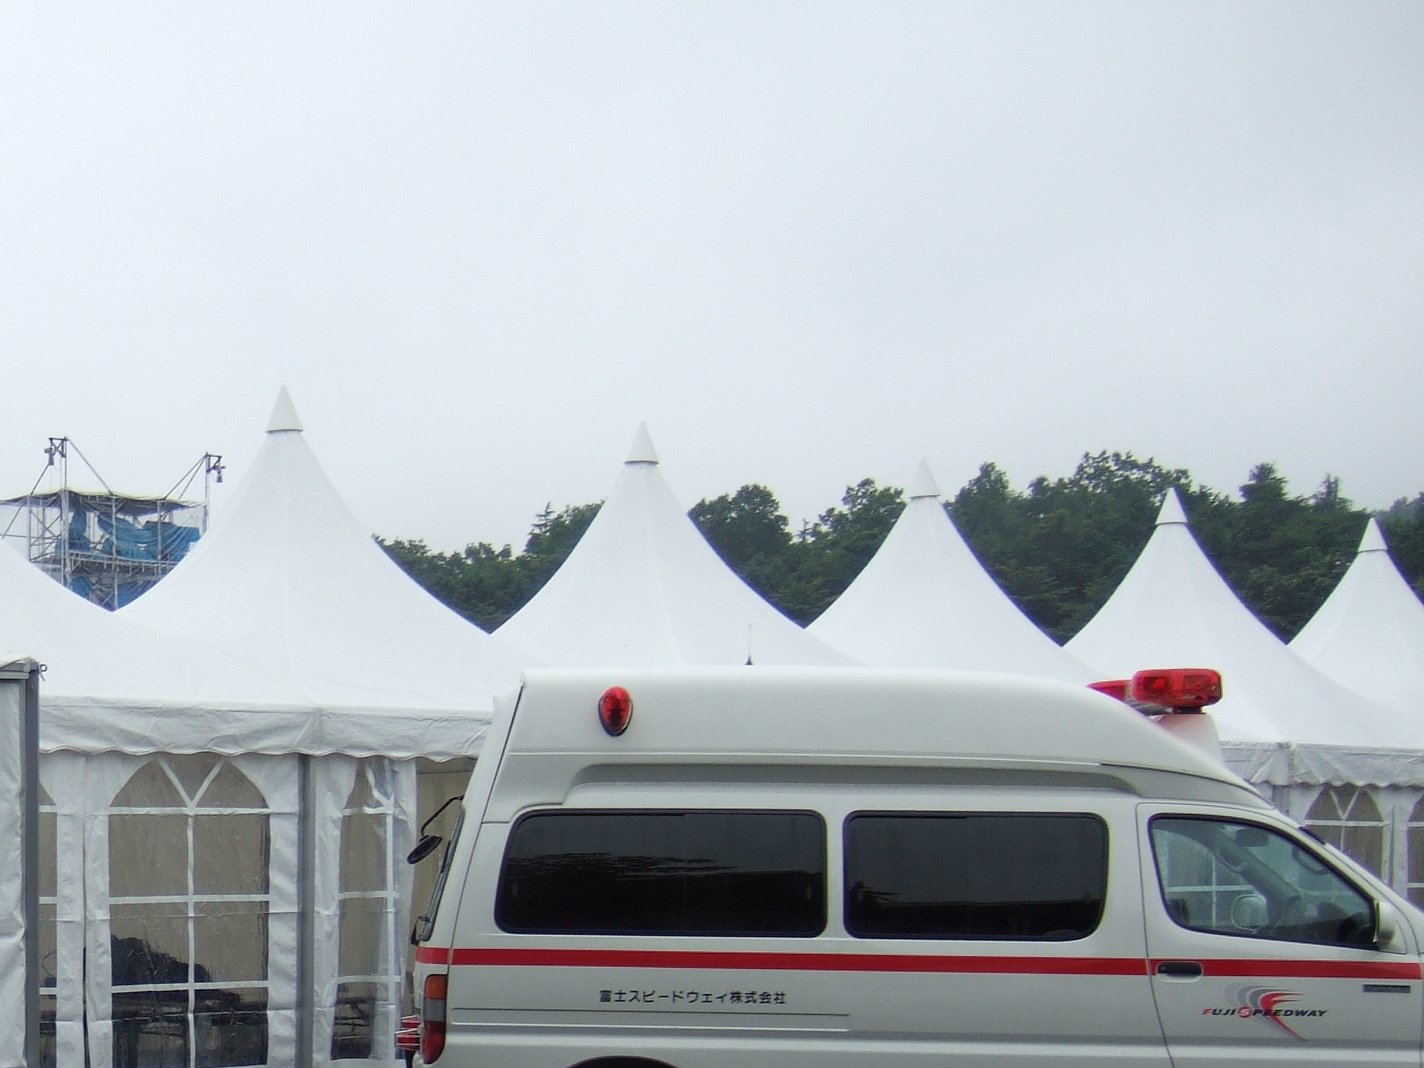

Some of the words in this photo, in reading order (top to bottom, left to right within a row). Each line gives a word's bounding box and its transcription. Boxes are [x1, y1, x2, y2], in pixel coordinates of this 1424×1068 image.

[599, 989, 786, 1005] 富士スピードウェイ株式会社
